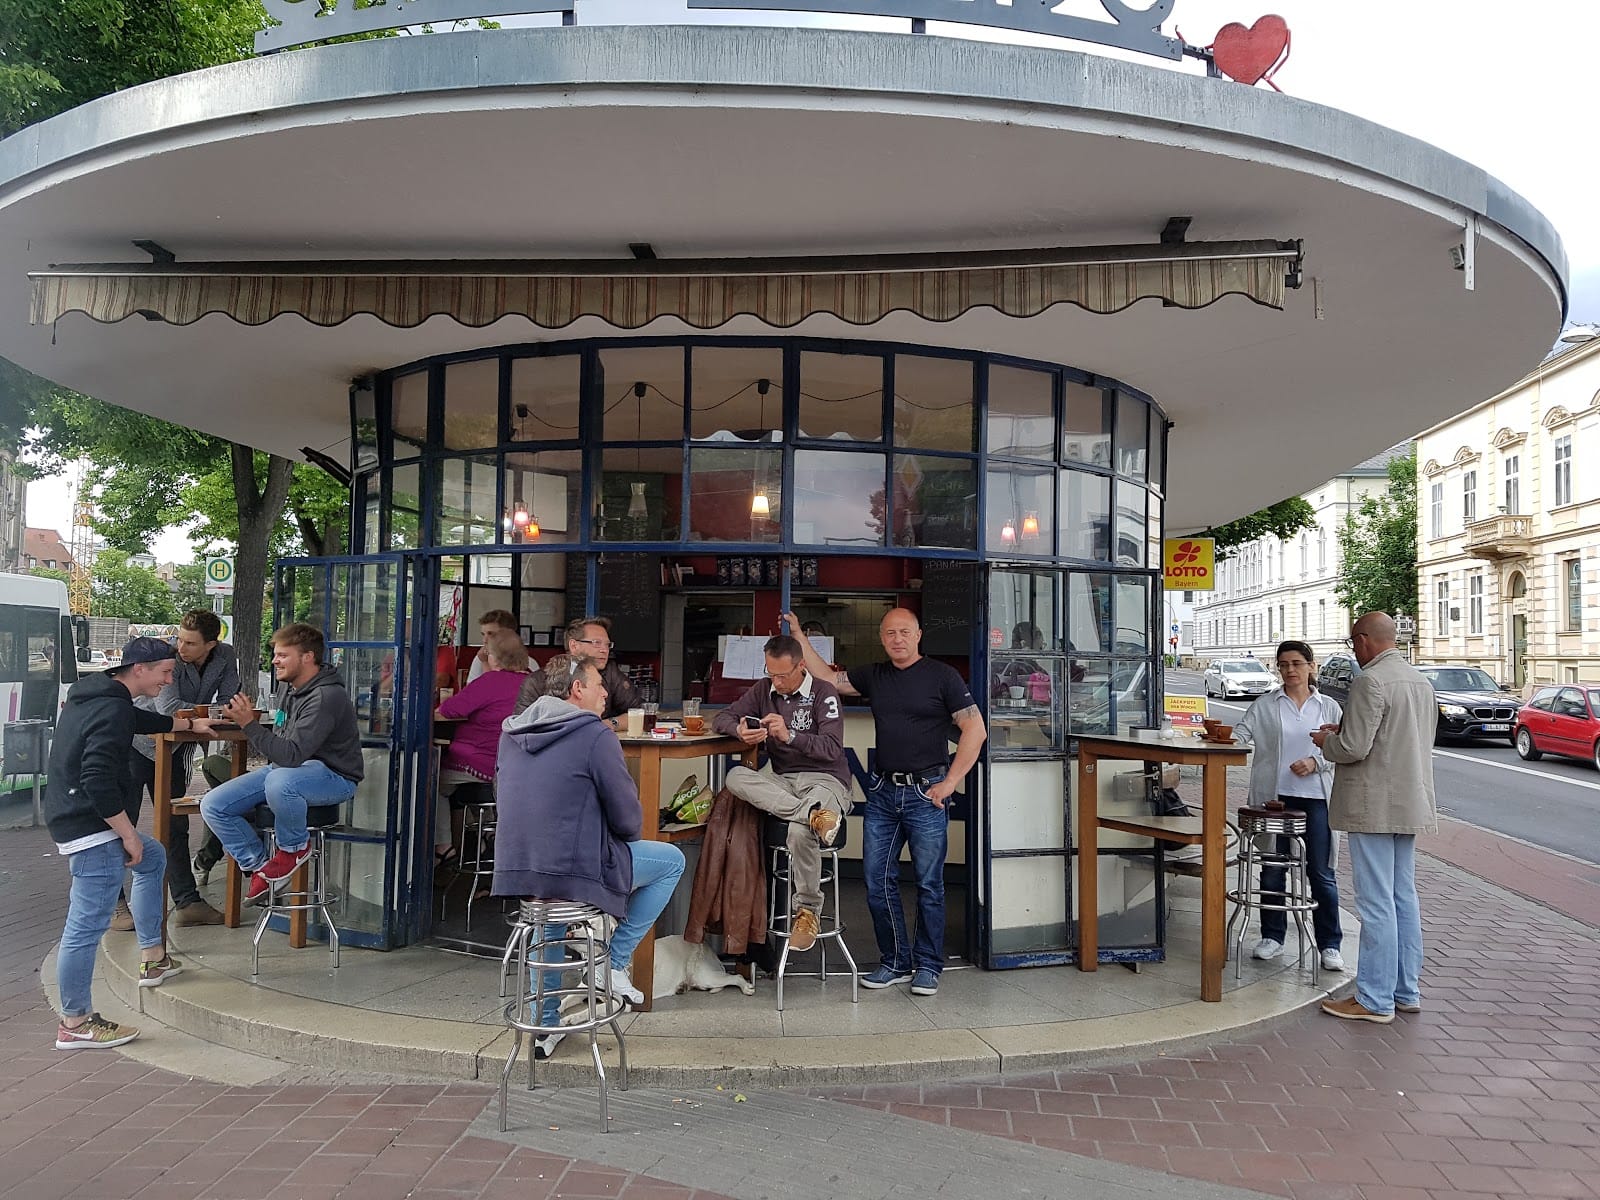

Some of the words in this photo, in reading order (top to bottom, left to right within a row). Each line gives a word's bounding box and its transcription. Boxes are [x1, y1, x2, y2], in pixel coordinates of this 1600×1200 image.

[215, 563, 225, 577] H
[1165, 566, 1208, 577] LOTTO
[1175, 580, 1199, 588] Bayern
[824, 696, 839, 719] 3
[1191, 715, 1203, 723] 19
